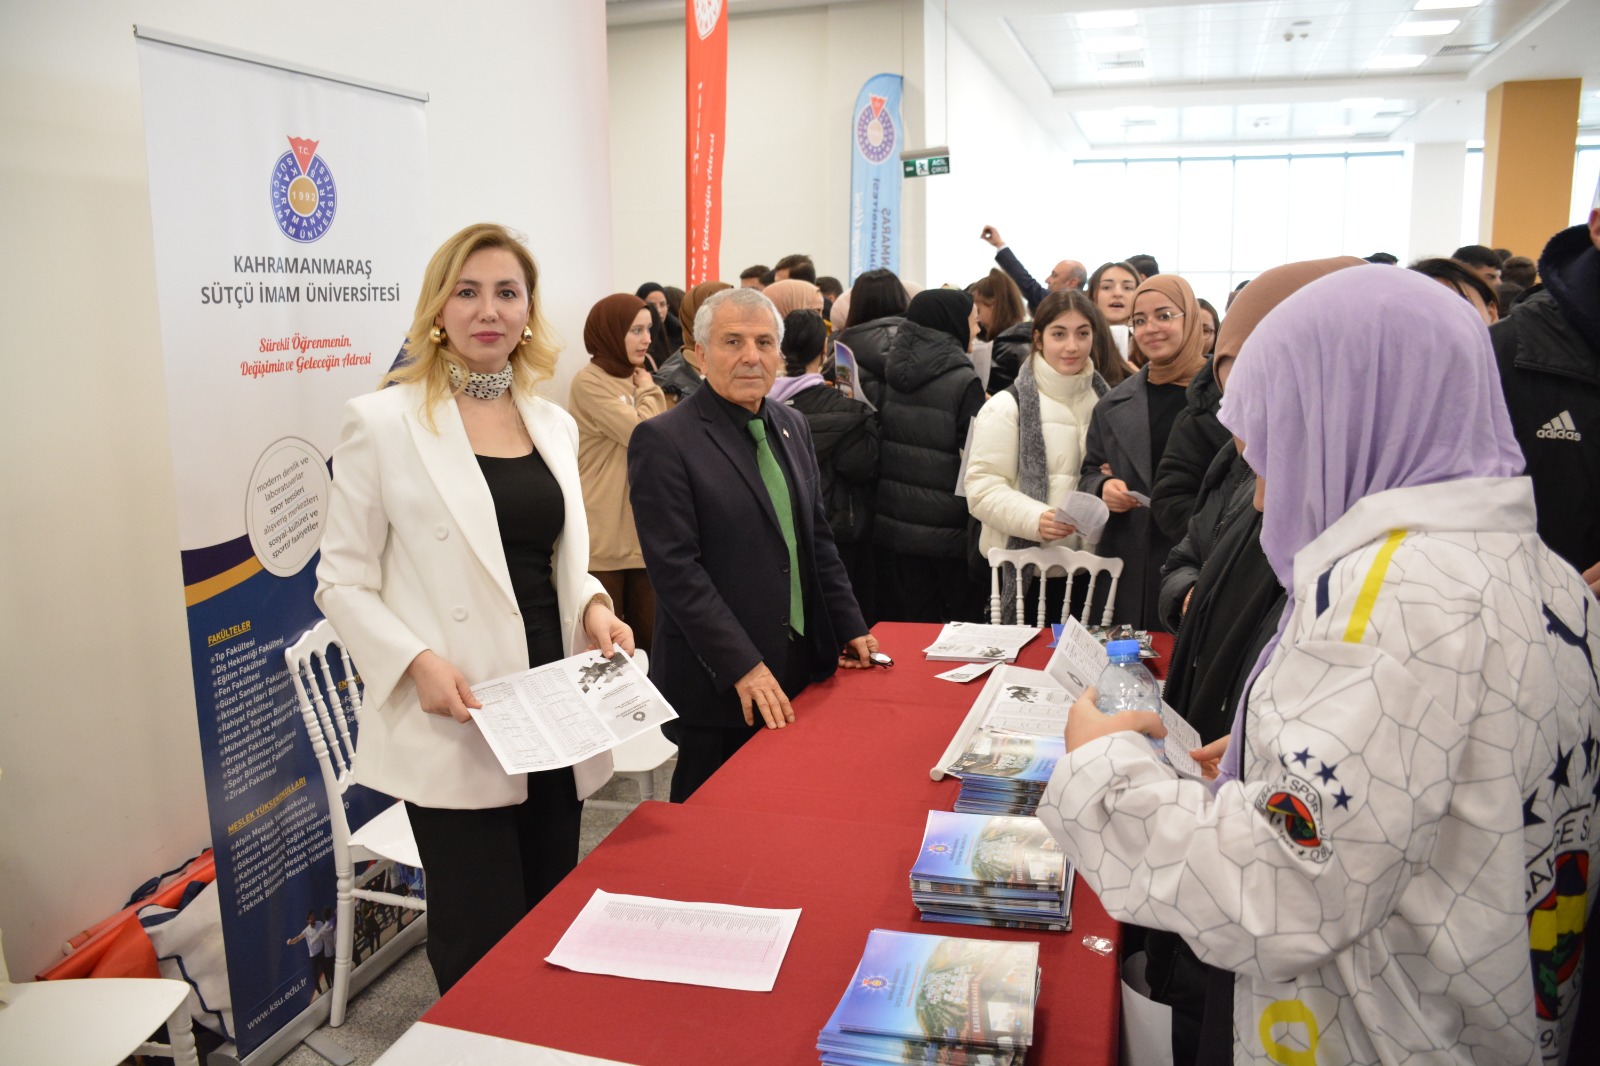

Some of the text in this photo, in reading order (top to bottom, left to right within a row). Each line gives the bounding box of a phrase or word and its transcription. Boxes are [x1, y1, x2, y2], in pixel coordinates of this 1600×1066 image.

[292, 192, 315, 202] 1992
[234, 256, 372, 279] KAHRAMANMARAŞ
[201, 282, 400, 309] SÜTÇÜ İMAM ÜNİVERSİTESİ
[260, 333, 351, 353] Sürekli Öğrenmenin,
[240, 353, 371, 379] Değişimin ve Geleceğin Adresi
[1536, 429, 1581, 441] adidas
[257, 474, 281, 493] modern
[270, 502, 284, 515] spor
[288, 493, 319, 518] merkezleri
[310, 510, 318, 518] ve
[208, 620, 251, 645] FAKÜLTELER
[215, 637, 255, 661] Tıp Fakültesi
[216, 636, 284, 674] Diş Hekimliği Fakültesi
[217, 656, 267, 686] Eğitim Fakültesi
[219, 670, 260, 697] Fen Fakültesi
[220, 693, 238, 708] Güzel
[239, 681, 264, 699] Sanatlar
[265, 670, 290, 685] Fakültes
[245, 699, 252, 707] ve
[268, 679, 289, 696] Bilimler
[247, 699, 274, 718] Fakültesi
[223, 730, 240, 742] İnsan
[242, 725, 249, 733] ve
[250, 712, 272, 728] Toplum
[226, 732, 276, 766] Orman Fakültesi
[227, 761, 247, 777] Sağlık
[248, 744, 274, 765] Bilimleri
[228, 775, 243, 788] Spor
[244, 758, 271, 778] Bilimleri
[229, 765, 276, 800] Ziraat Fakültesi
[228, 776, 306, 834] MESLEK YÜKSEKOKULLARI
[1290, 780, 1318, 814] SPOR
[235, 834, 251, 849] Afşin
[252, 820, 274, 837] Meslek
[260, 825, 280, 844] Meslek
[286, 830, 306, 846] Sağlık
[237, 851, 261, 870] Göksun
[262, 835, 281, 854] Meslek
[240, 869, 267, 892] Pazarcık
[286, 830, 324, 856] Yüksekokulu
[241, 883, 262, 902] Sosyal
[284, 852, 307, 869] Meslek
[243, 894, 265, 912] Teknik
[286, 861, 308, 879] Meslek
[246, 977, 307, 1030] www.ksu.edu.tr
